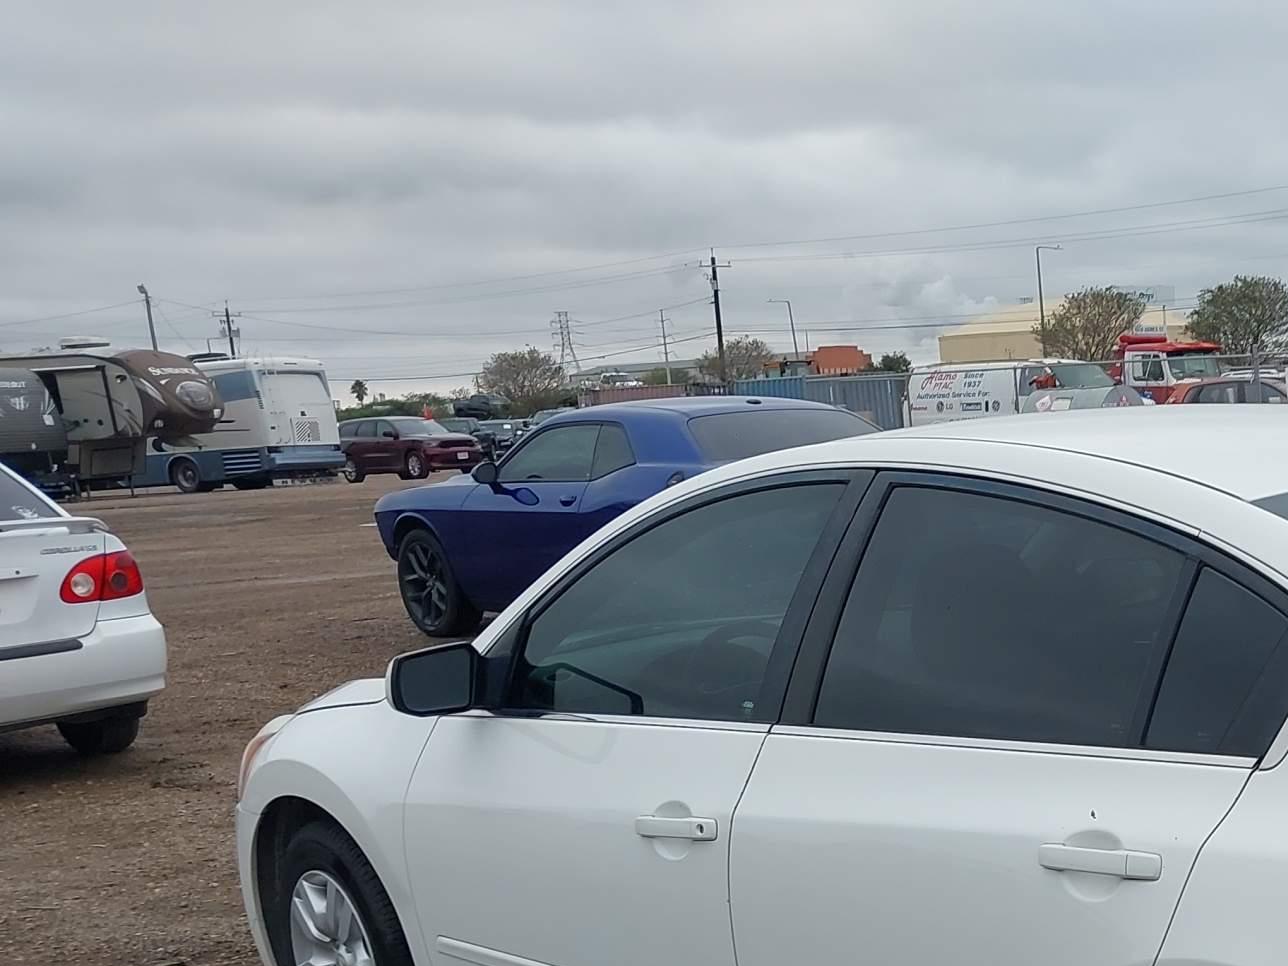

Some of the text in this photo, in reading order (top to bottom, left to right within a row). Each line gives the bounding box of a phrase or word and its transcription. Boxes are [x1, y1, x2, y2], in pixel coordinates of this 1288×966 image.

[921, 370, 957, 390] Alamo
[963, 380, 982, 388] 1937
[917, 391, 950, 400] Authorized
[952, 389, 976, 398] Service
